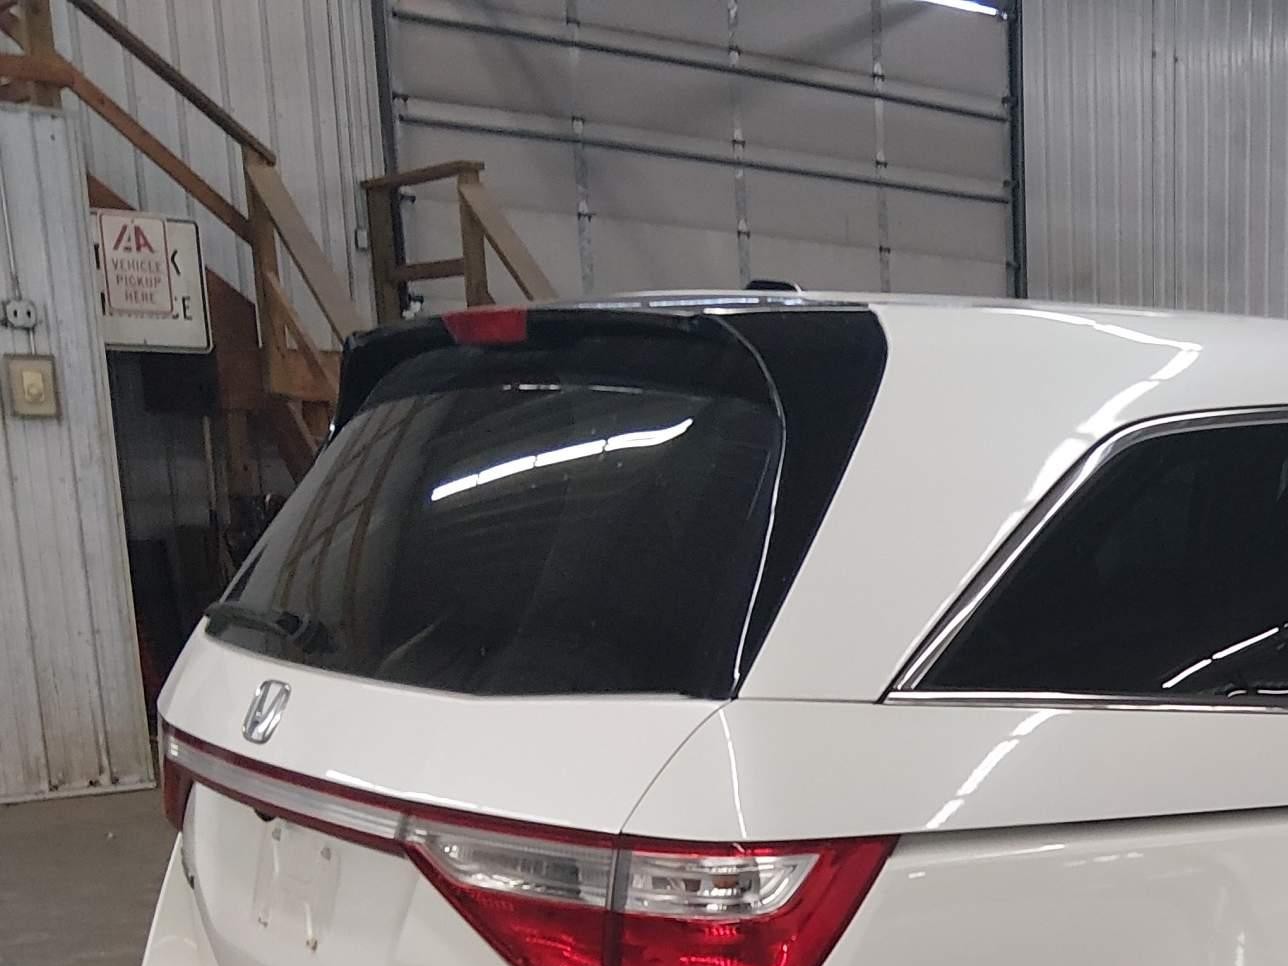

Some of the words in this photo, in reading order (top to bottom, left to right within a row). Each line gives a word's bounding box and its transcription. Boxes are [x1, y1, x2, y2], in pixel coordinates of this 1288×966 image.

[112, 257, 162, 273] VEHICLE
[116, 274, 162, 289] PICKUP
[125, 290, 156, 304] HERE
